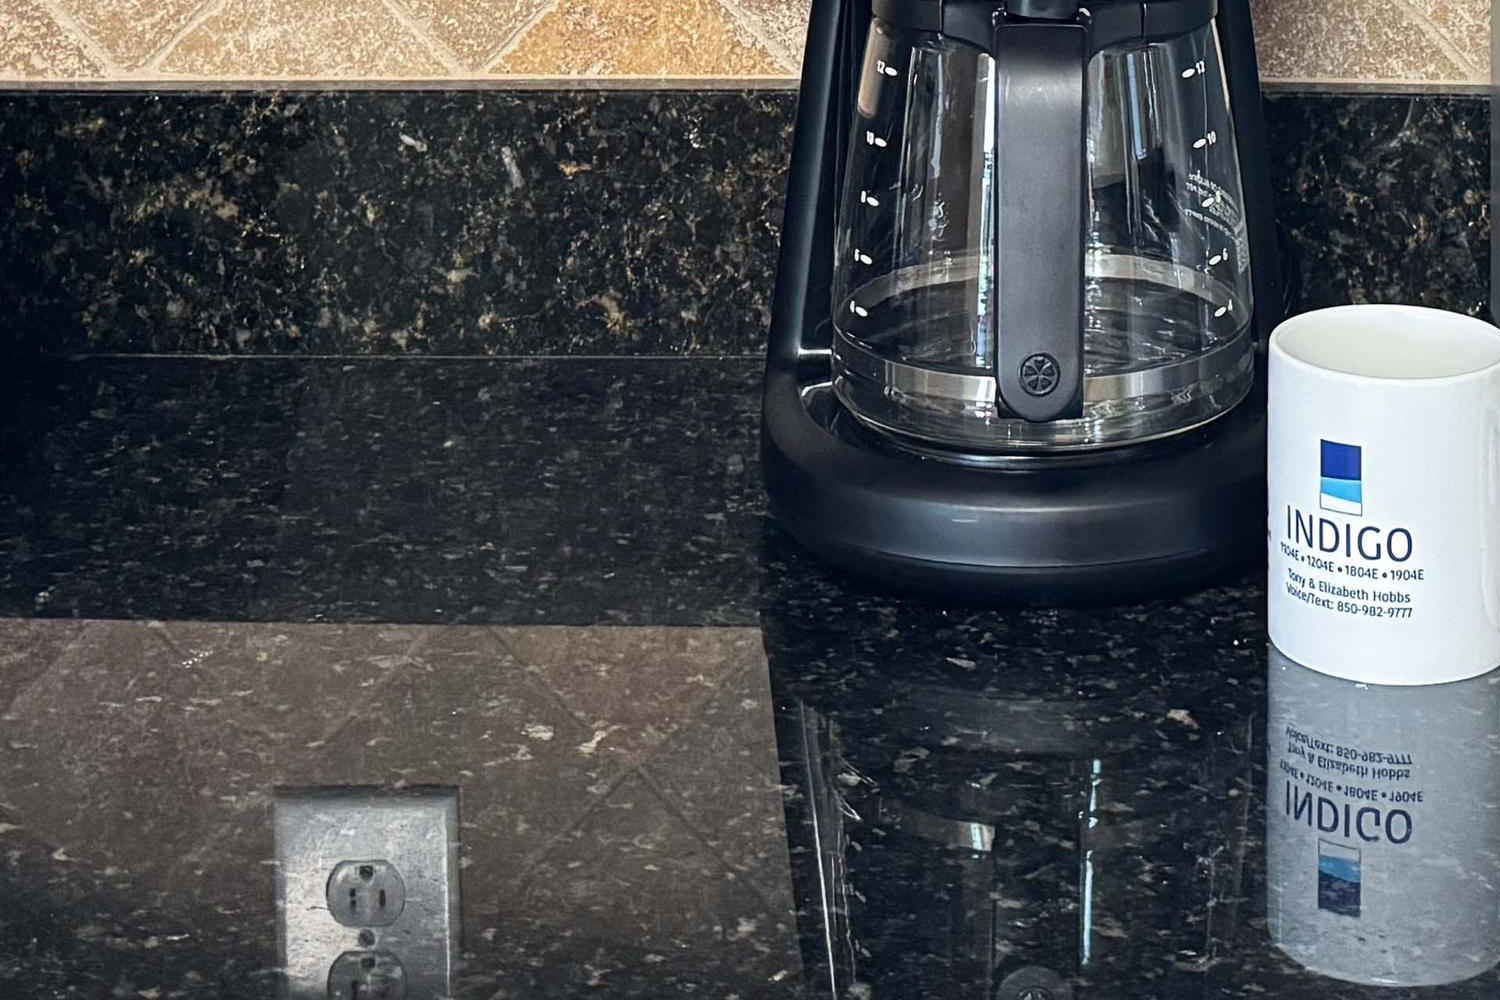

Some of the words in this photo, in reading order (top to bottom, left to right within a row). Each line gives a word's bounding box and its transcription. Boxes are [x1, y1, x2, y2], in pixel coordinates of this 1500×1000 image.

[1287, 504, 1413, 562] INDIGO
[1307, 553, 1334, 572] 1204E
[1345, 565, 1379, 580] 1804E
[1390, 568, 1424, 581] 1904E
[1308, 578, 1316, 589] &
[1319, 580, 1369, 601] Elizabeth
[1373, 591, 1411, 603] Hobbs
[1337, 601, 1413, 619] 850-982-9777
